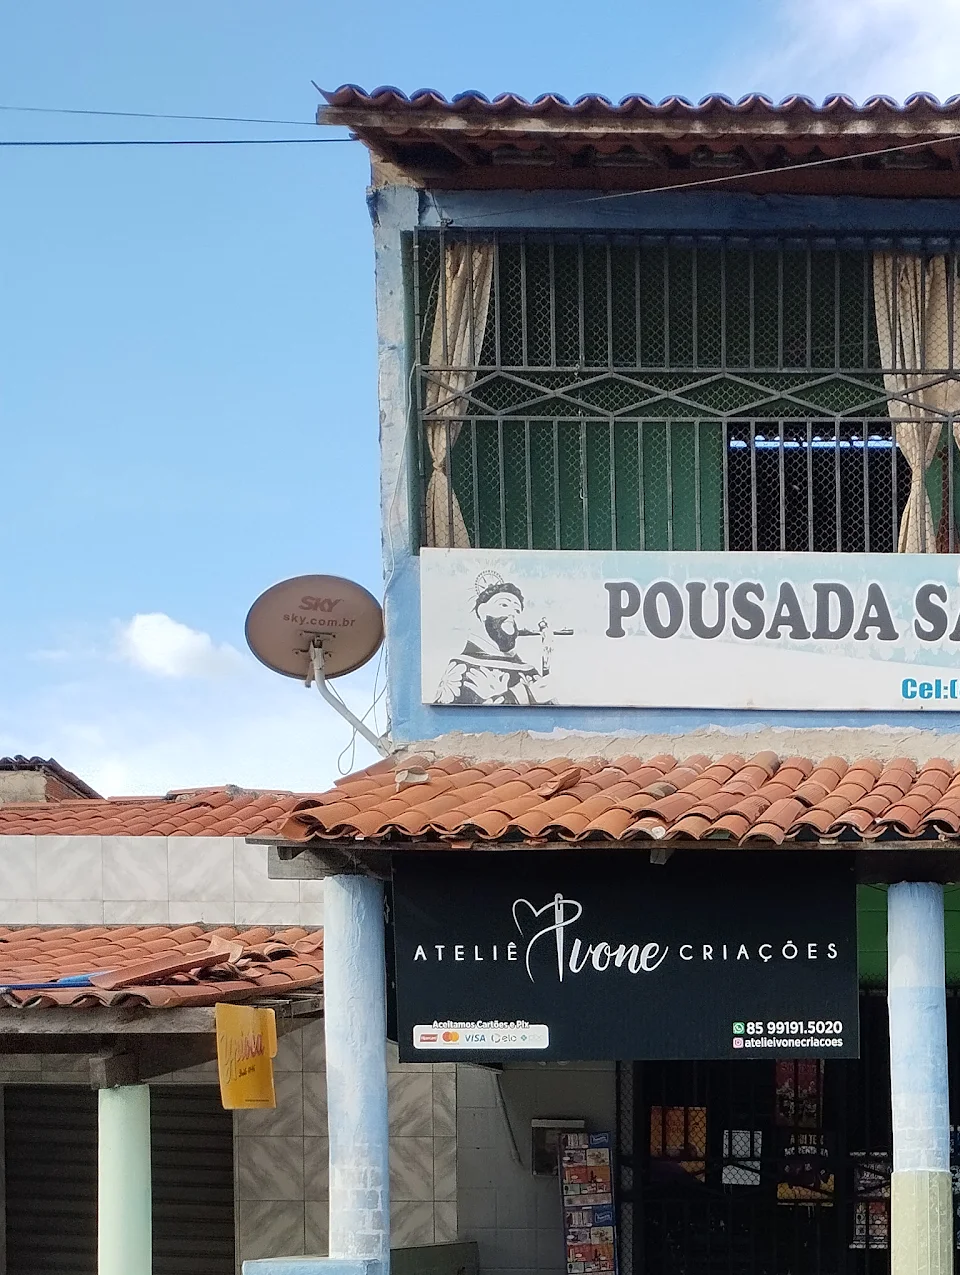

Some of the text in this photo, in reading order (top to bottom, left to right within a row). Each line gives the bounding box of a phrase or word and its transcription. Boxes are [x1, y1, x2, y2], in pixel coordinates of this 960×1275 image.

[298, 595, 342, 612] SKY
[604, 581, 900, 640] POUSADA
[283, 613, 356, 627] sky.com.br
[413, 941, 518, 961] ATELIÊ
[678, 940, 839, 963] CRIAÇÕES
[432, 1020, 475, 1030] Aceitamos
[476, 1020, 508, 1030] Cartões
[516, 1020, 530, 1029] Pix
[746, 1020, 843, 1035] 85 99191.5020
[464, 1033, 487, 1043] VISA
[744, 1036, 844, 1048] atelieivonecriacoes
